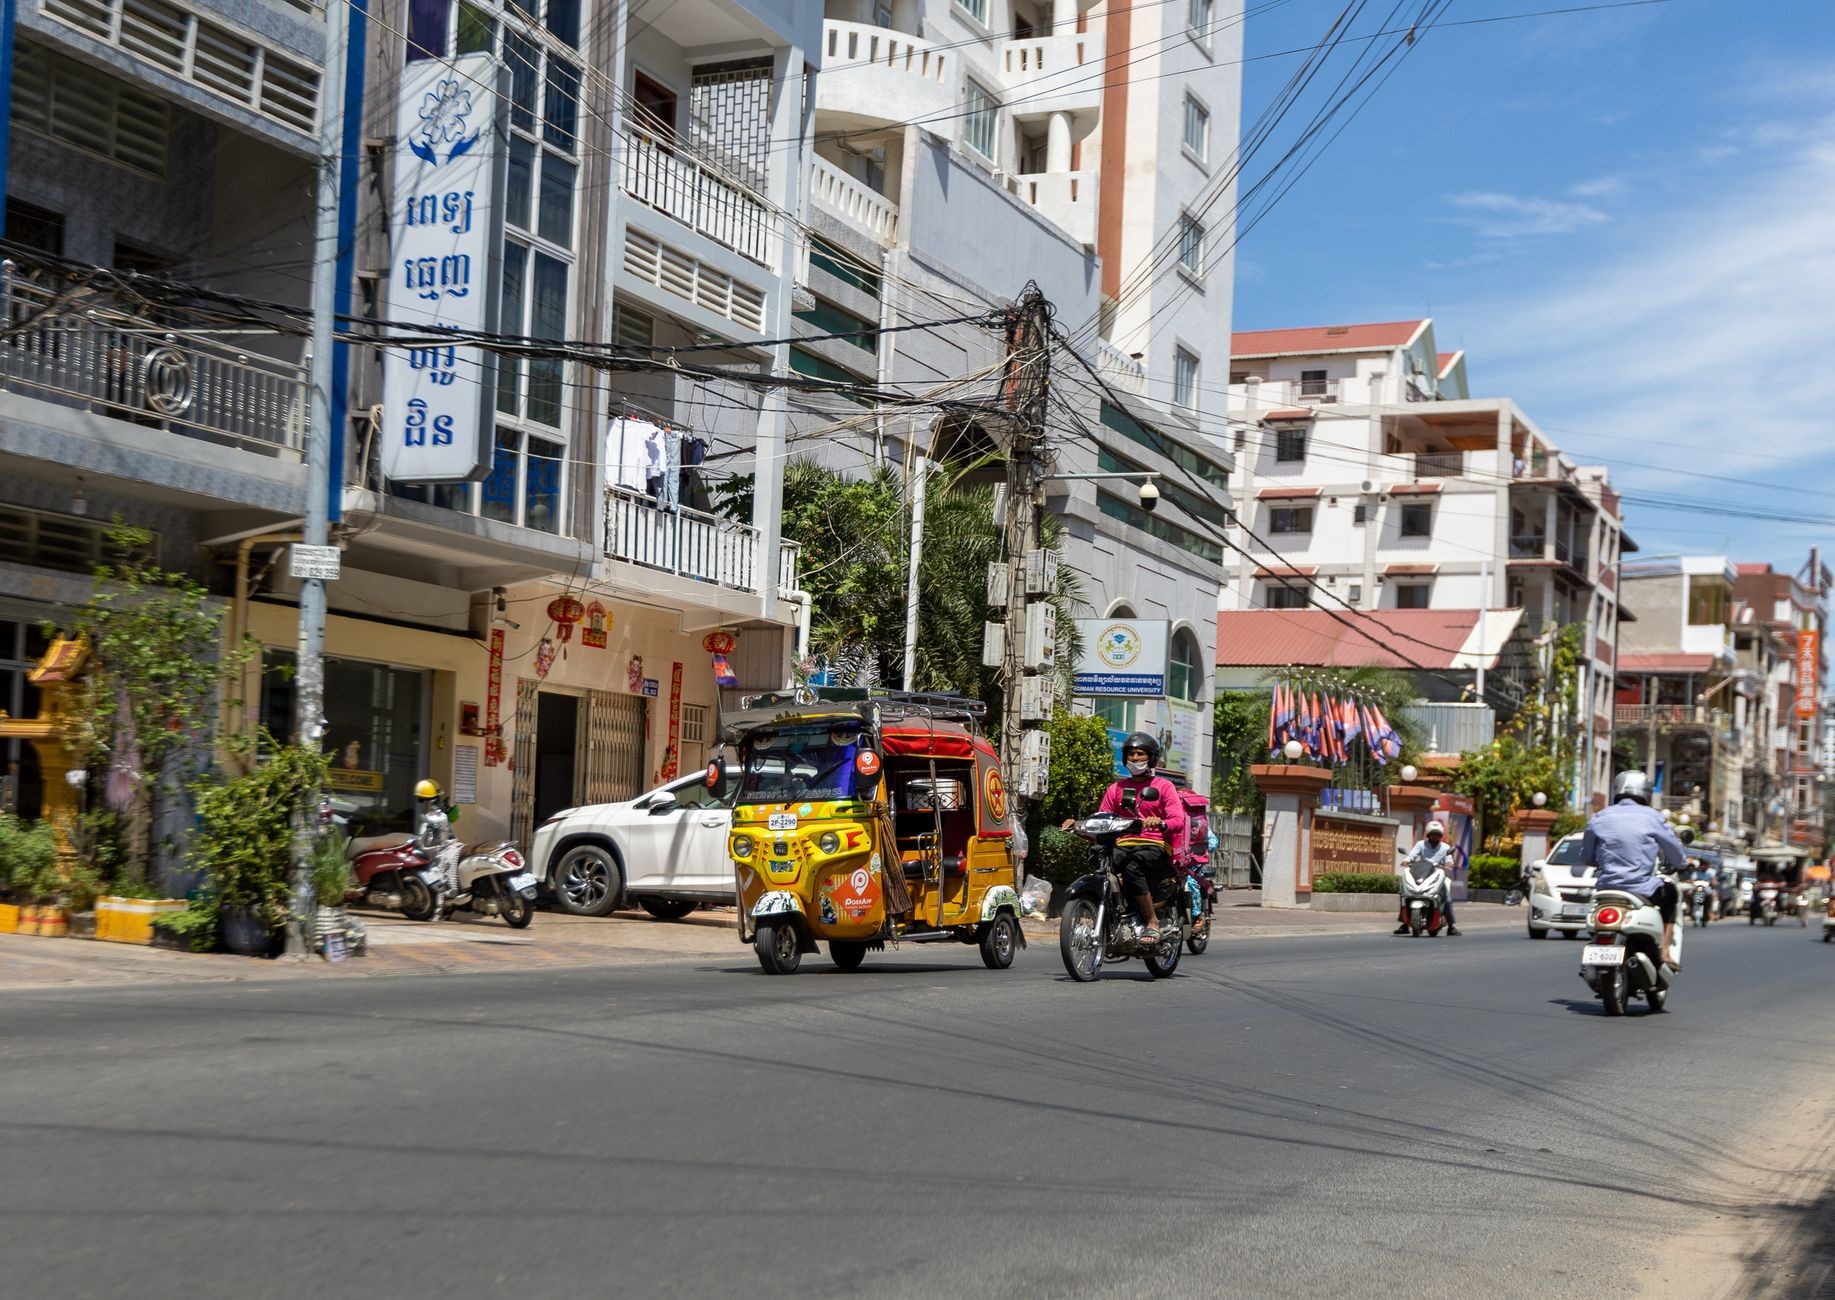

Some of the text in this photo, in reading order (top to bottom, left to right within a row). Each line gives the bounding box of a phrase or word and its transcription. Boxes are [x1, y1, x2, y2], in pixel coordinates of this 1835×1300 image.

[406, 190, 475, 234] ពេទ្យ
[404, 254, 471, 301] ធ្មេញ
[770, 818, 796, 826] 2P-2290
